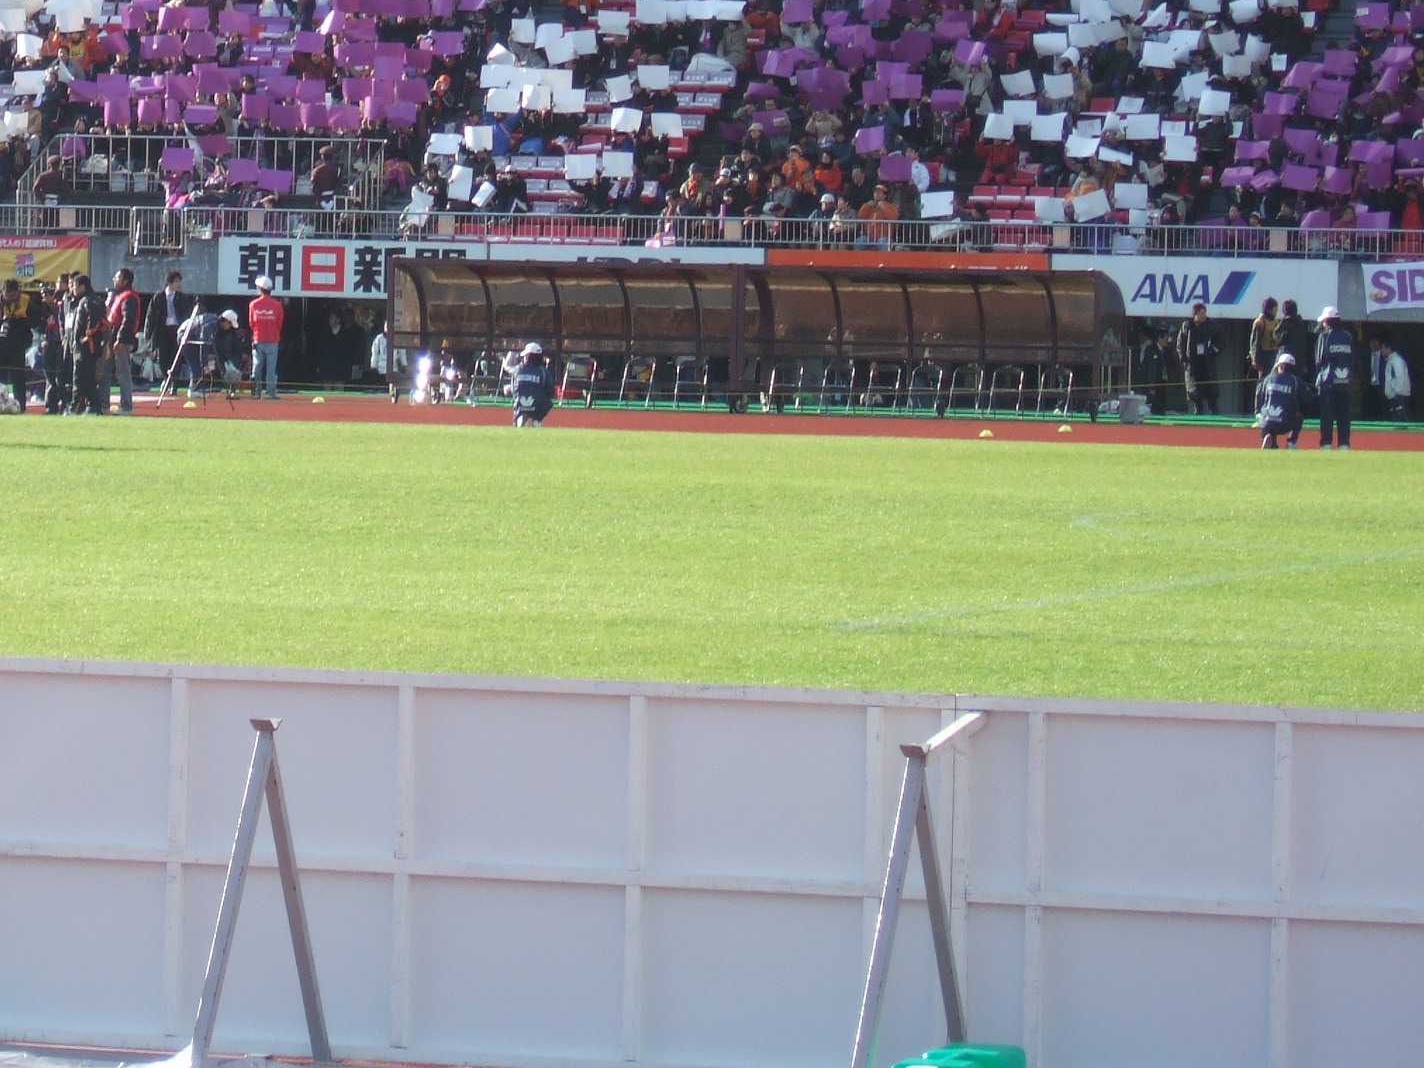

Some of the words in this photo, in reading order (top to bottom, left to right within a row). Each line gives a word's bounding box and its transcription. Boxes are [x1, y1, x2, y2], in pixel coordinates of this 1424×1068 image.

[238, 243, 466, 293] 朝日新
[1131, 272, 1210, 304] ANA
